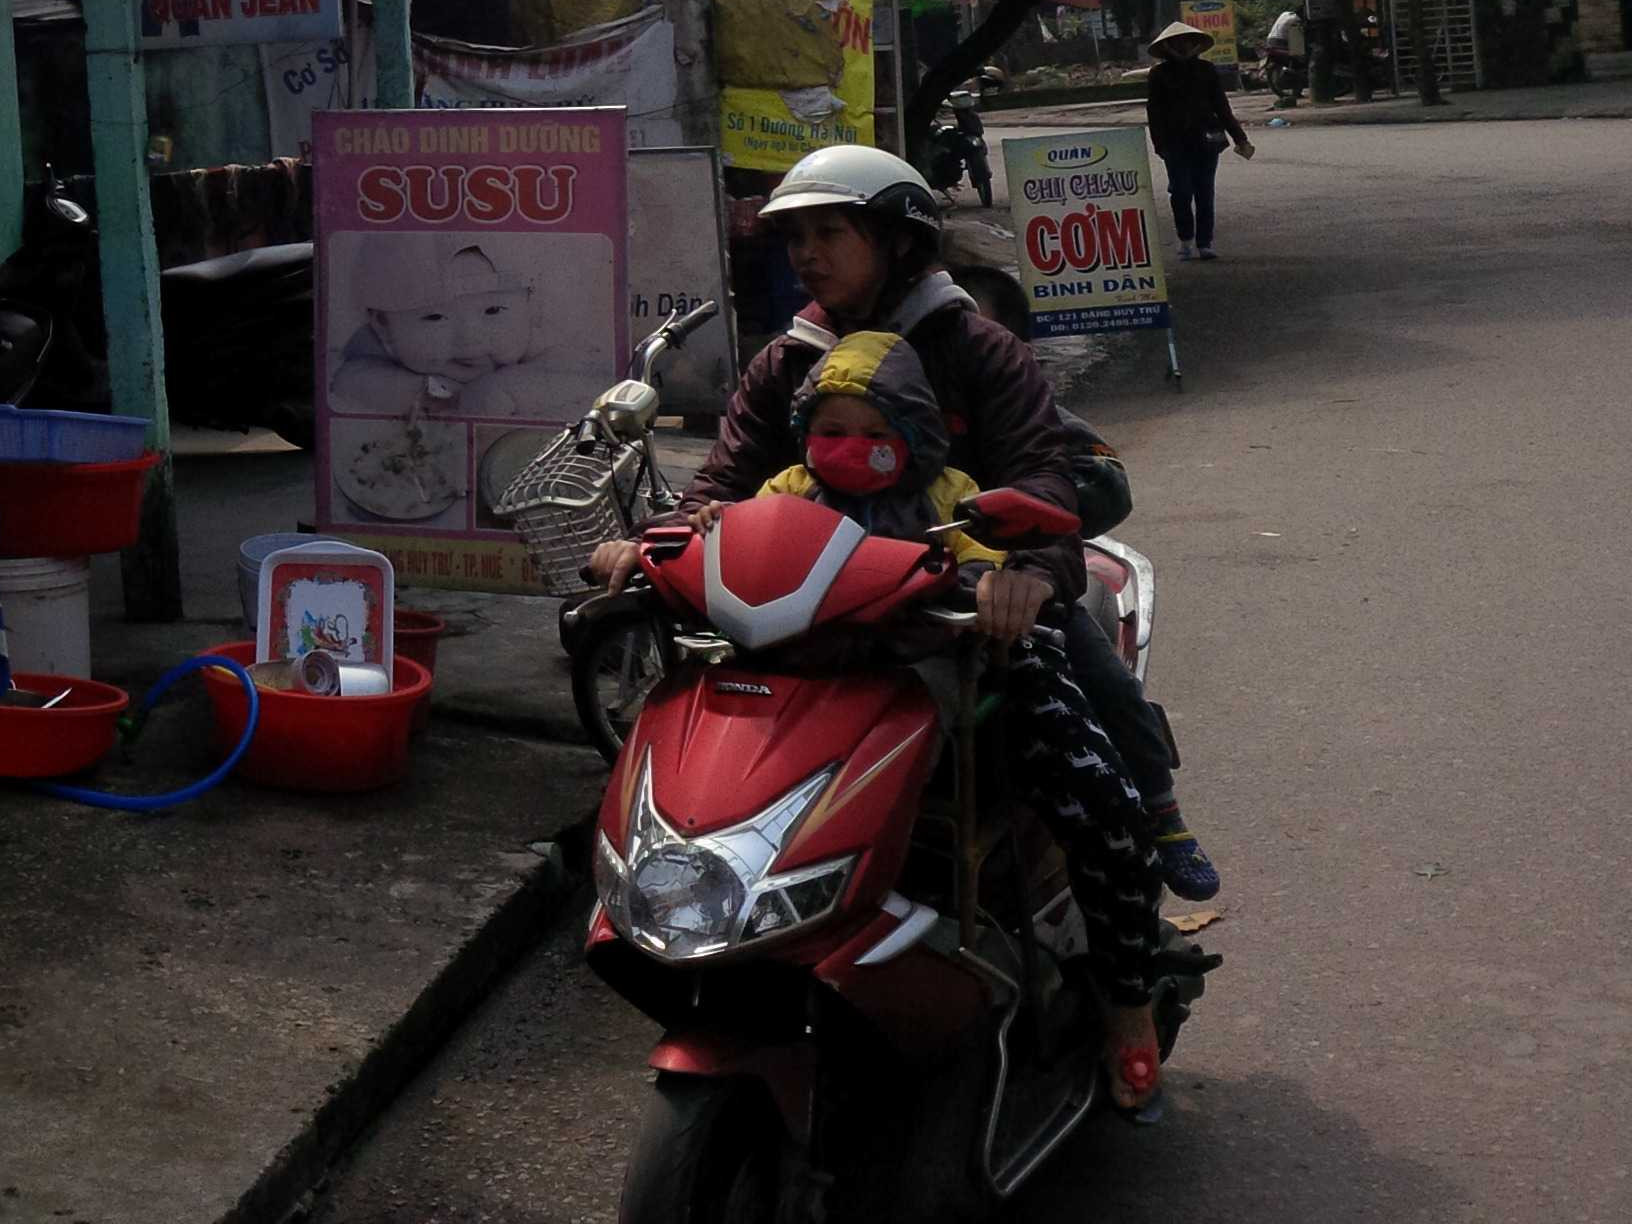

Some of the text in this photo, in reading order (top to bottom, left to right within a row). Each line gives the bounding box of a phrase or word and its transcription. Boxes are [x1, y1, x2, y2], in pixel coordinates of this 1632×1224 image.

[420, 124, 489, 153] DINH
[749, 116, 755, 132] 1
[357, 164, 579, 225] SUSU
[1025, 203, 1152, 276] CƠM
[1034, 279, 1093, 299] BÌNH
[1102, 274, 1156, 293] DÂN
